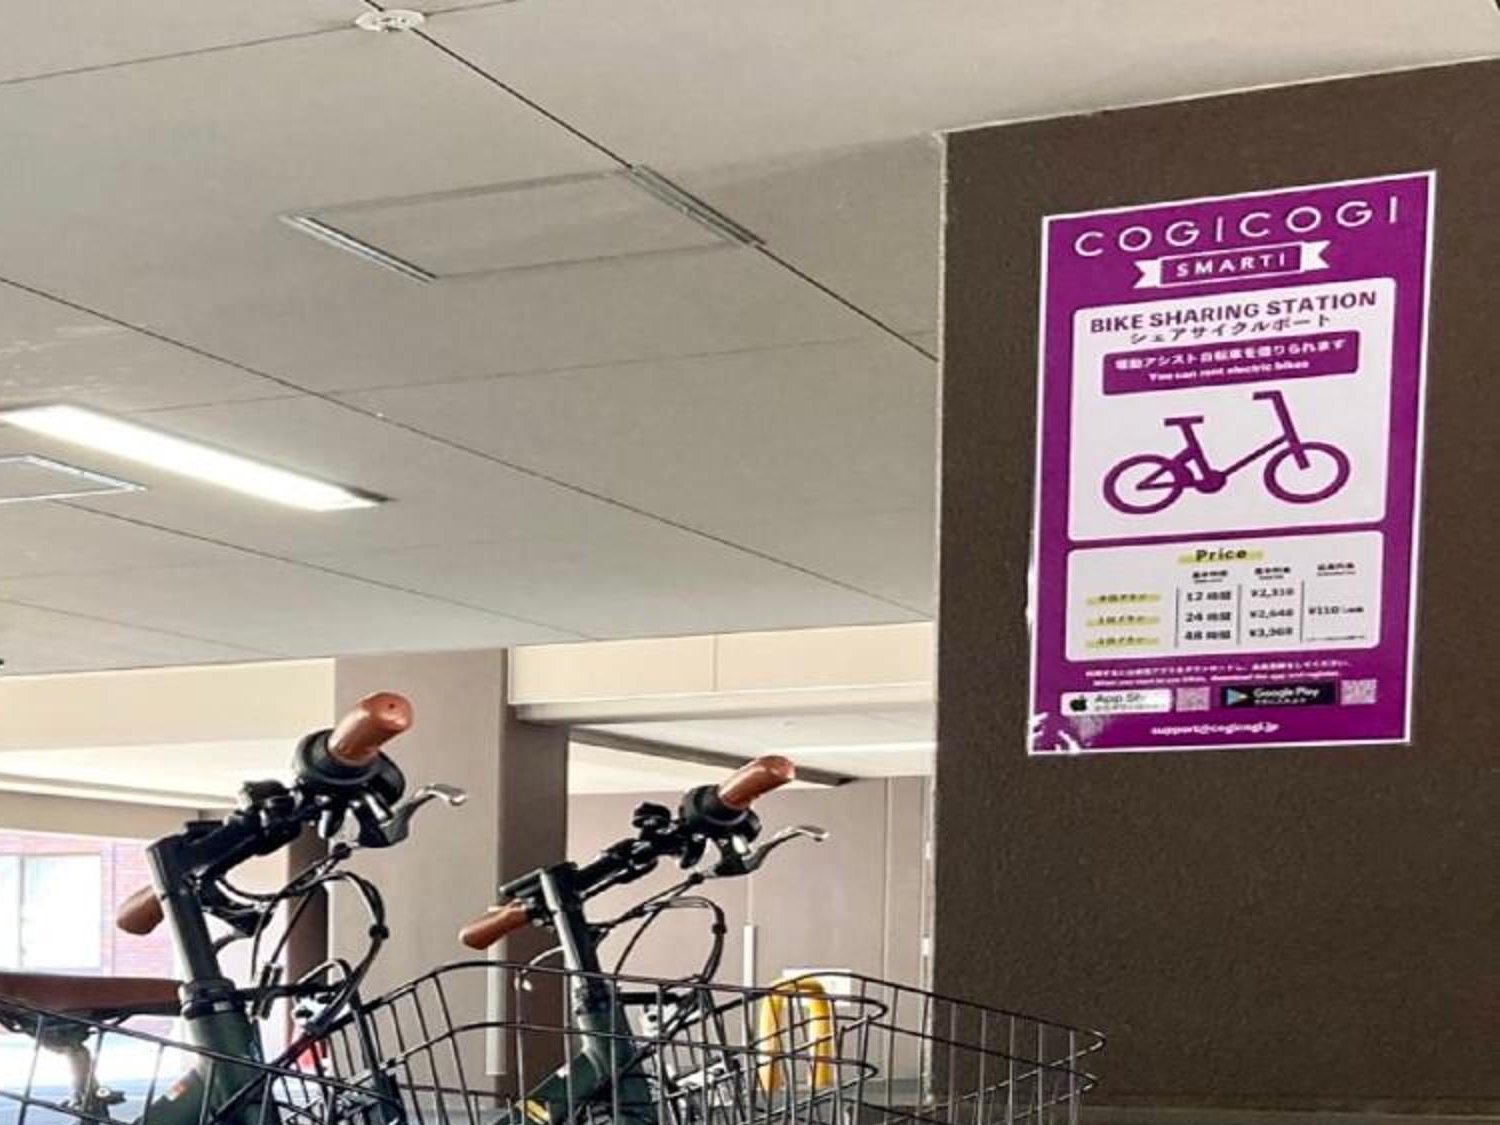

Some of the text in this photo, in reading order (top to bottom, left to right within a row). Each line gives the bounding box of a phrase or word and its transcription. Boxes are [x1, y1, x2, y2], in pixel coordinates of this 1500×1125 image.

[1075, 197, 1398, 256] COGICOGI
[1090, 291, 1377, 333] BIKE SHARING STATION
[1195, 549, 1247, 562] Price
[1253, 686, 1320, 699] Google Play
